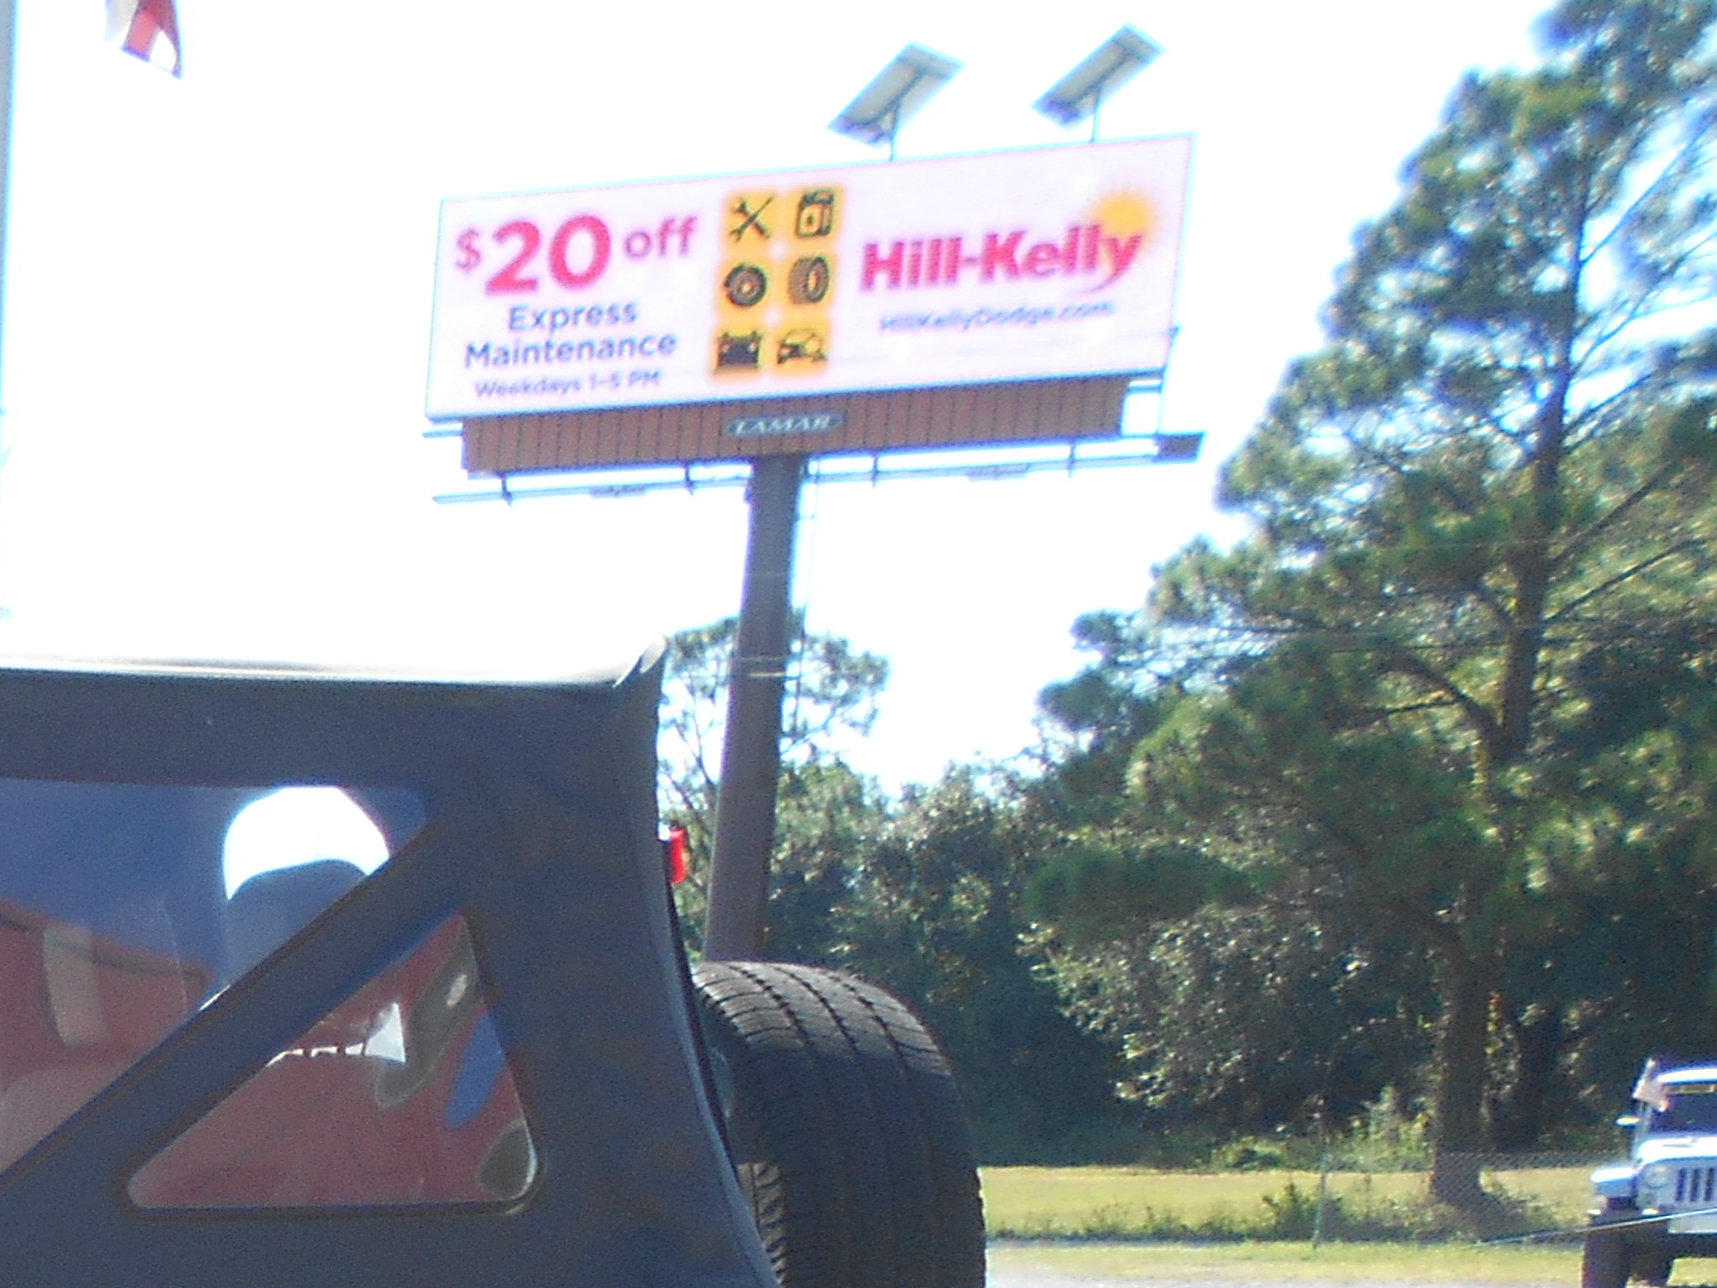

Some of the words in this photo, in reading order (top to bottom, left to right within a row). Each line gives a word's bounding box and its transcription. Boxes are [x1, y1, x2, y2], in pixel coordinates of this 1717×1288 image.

[454, 214, 612, 294] $20
[623, 216, 698, 258] off
[862, 224, 1145, 293] Hill-Kelly
[509, 302, 640, 333] Express
[465, 333, 679, 368] Maintenance
[475, 377, 583, 399] Weekdays
[629, 369, 662, 387] PM
[735, 416, 830, 434] LAMAR
